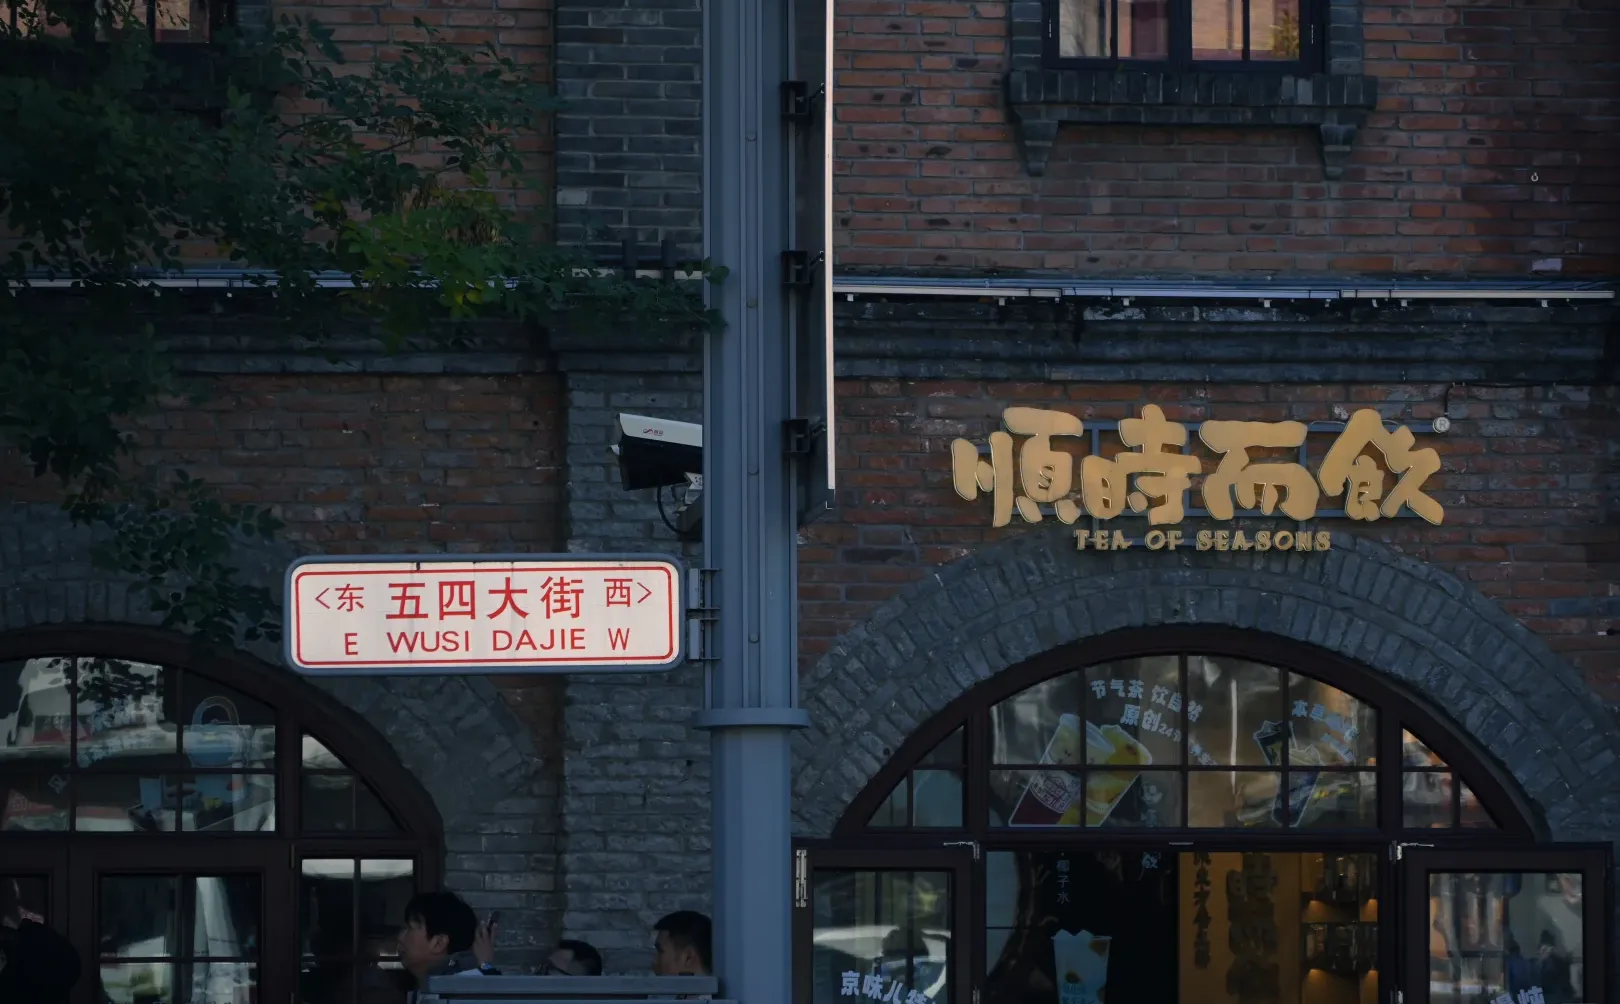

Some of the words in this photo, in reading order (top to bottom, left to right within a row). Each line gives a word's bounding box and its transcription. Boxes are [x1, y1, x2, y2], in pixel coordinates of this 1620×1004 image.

[1074, 529, 1132, 551] TEA
[1144, 529, 1184, 551] OF
[1196, 529, 1332, 552] SEASONS
[336, 583, 365, 613] 东
[386, 575, 585, 621] 五四大街
[604, 578, 633, 608] 西
[344, 632, 359, 656] E
[387, 630, 471, 653] WUSI
[492, 628, 587, 652] DAJIE
[607, 627, 631, 651] W
